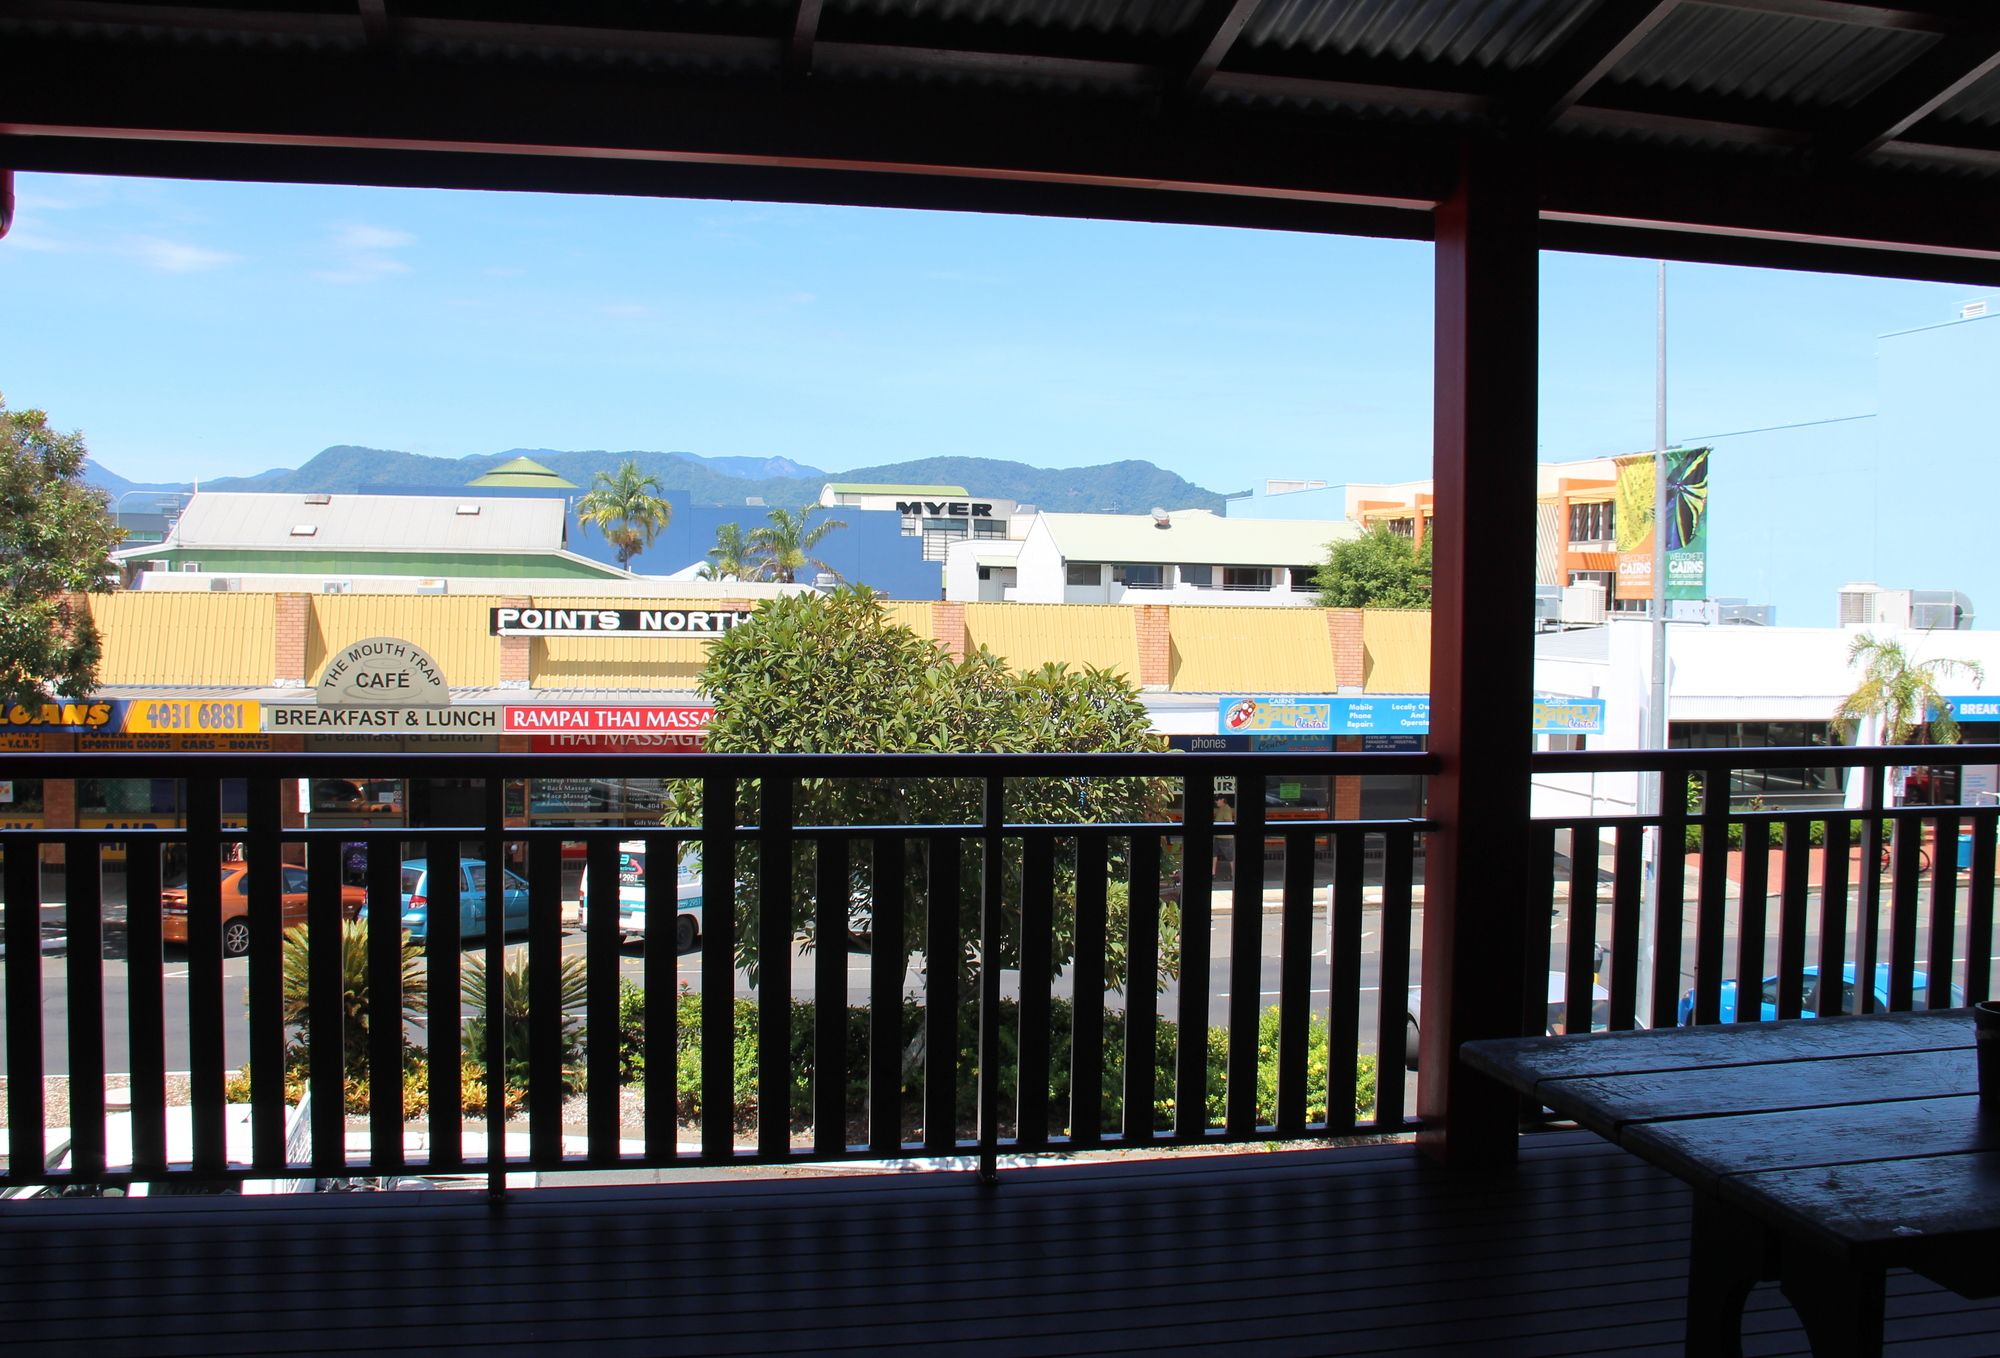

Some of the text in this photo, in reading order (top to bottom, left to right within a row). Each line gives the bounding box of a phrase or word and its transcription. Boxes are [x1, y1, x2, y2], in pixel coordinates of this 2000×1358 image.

[896, 502, 992, 516] MYER
[1620, 562, 1651, 574] CAIRNS
[1669, 561, 1704, 573] CAIRNS
[497, 609, 620, 630] POINTS
[325, 642, 441, 689] THE MOUTH TRAP
[356, 669, 410, 688] CAFÉ
[1960, 704, 1998, 714] BREAK
[146, 703, 243, 728] 4031 6881
[275, 710, 496, 726] BREAKFAST & LUNCH
[513, 710, 718, 728] RAMPAI THAI MASSA
[1401, 719, 1430, 727] Operate
[181, 740, 215, 749] CARS
[229, 740, 269, 749] BOATS
[550, 735, 597, 745] THAI
[1191, 737, 1226, 750] phones
[564, 785, 593, 793] Massage
[622, 874, 638, 882] 2951
